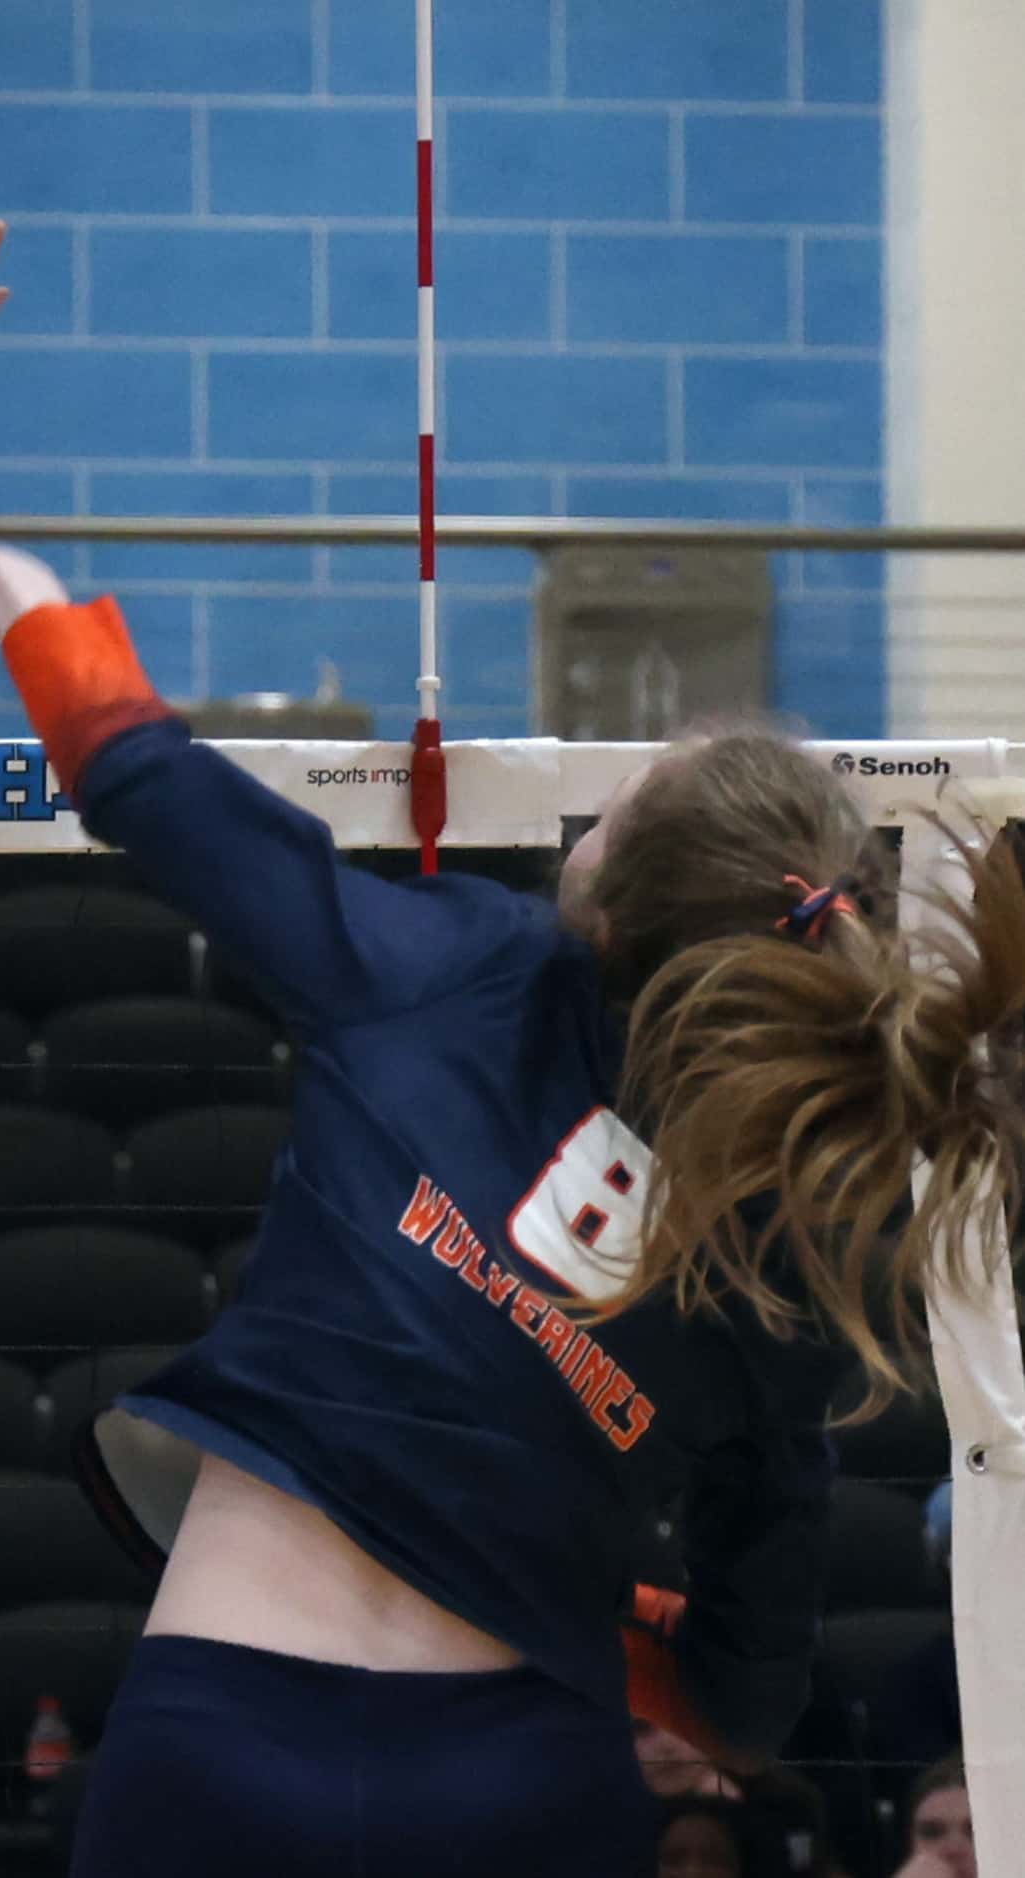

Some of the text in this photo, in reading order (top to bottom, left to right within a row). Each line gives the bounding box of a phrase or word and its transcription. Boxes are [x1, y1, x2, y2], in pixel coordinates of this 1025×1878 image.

[859, 757, 950, 776] Senoh
[307, 767, 412, 787] sports imp
[397, 1174, 656, 1453] WOLVERINES
